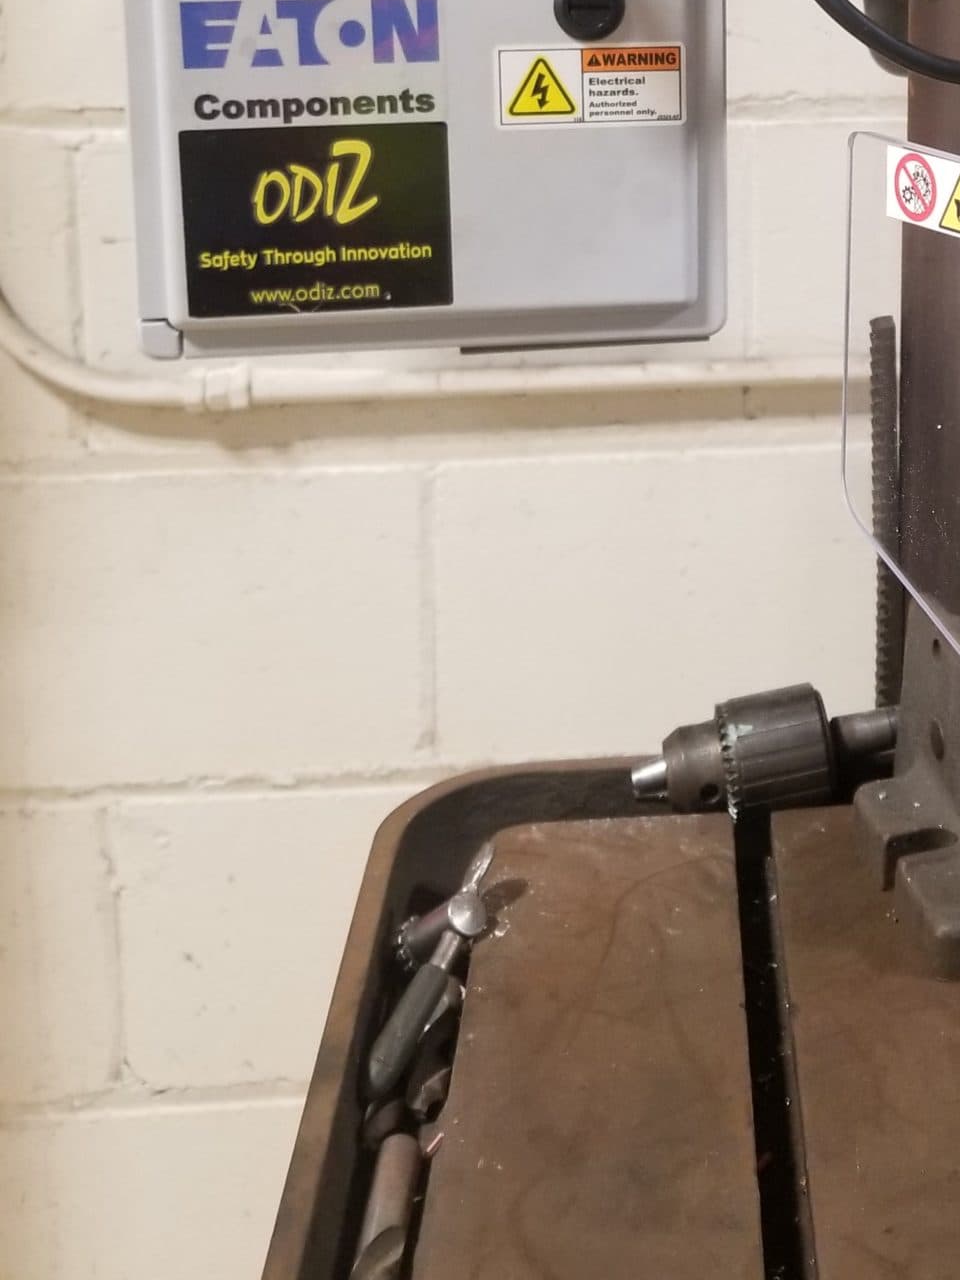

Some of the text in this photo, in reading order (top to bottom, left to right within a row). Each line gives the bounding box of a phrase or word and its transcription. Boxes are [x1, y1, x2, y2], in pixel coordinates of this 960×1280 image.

[602, 52, 677, 66] WARNING
[588, 76, 646, 86] Electrical
[588, 88, 639, 97] hazards.
[193, 87, 435, 124] Components
[589, 100, 637, 108] Authorized
[200, 242, 433, 271] Safety Through Innovation
[250, 282, 381, 305] www.odiz.com
